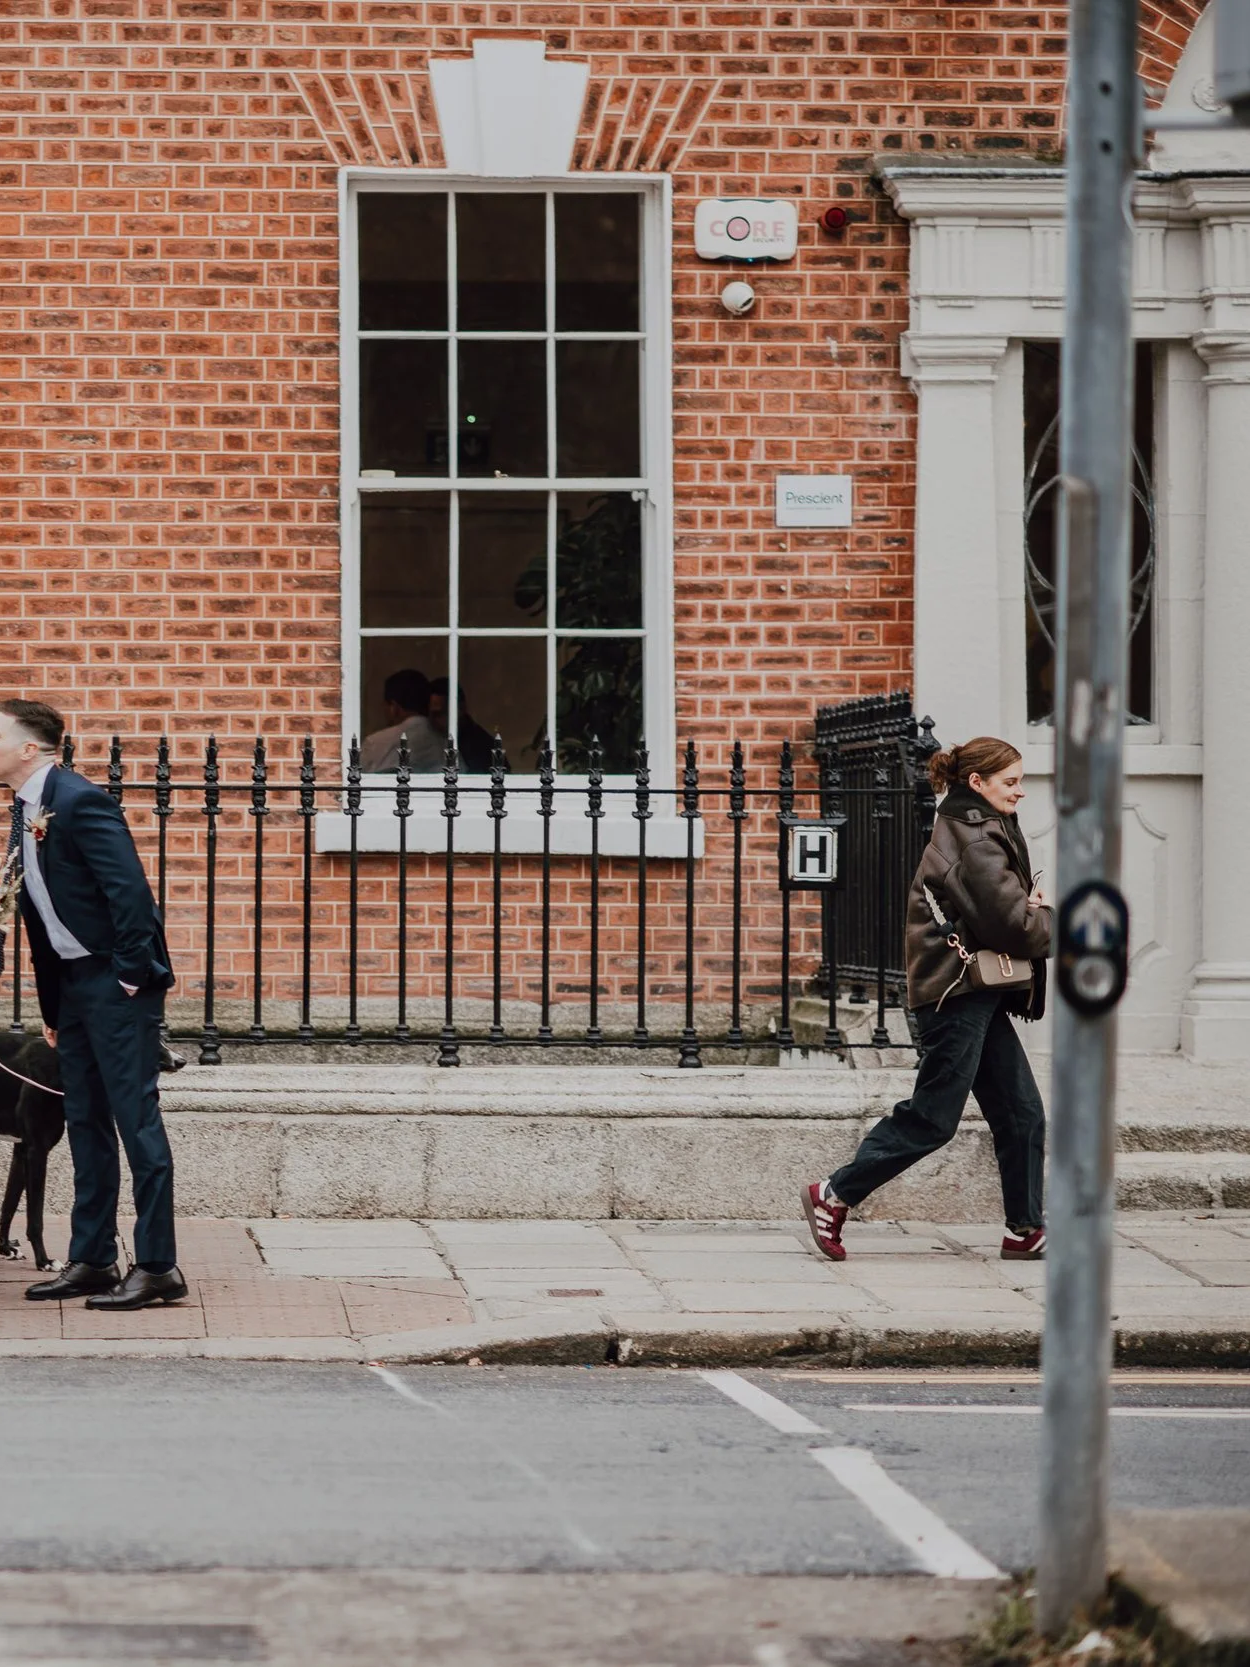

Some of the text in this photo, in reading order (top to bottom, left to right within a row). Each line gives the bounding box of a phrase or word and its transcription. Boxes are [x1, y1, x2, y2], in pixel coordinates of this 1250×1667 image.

[710, 217, 786, 240] CORE
[785, 491, 844, 504] Prescient
[799, 835, 827, 873] H
